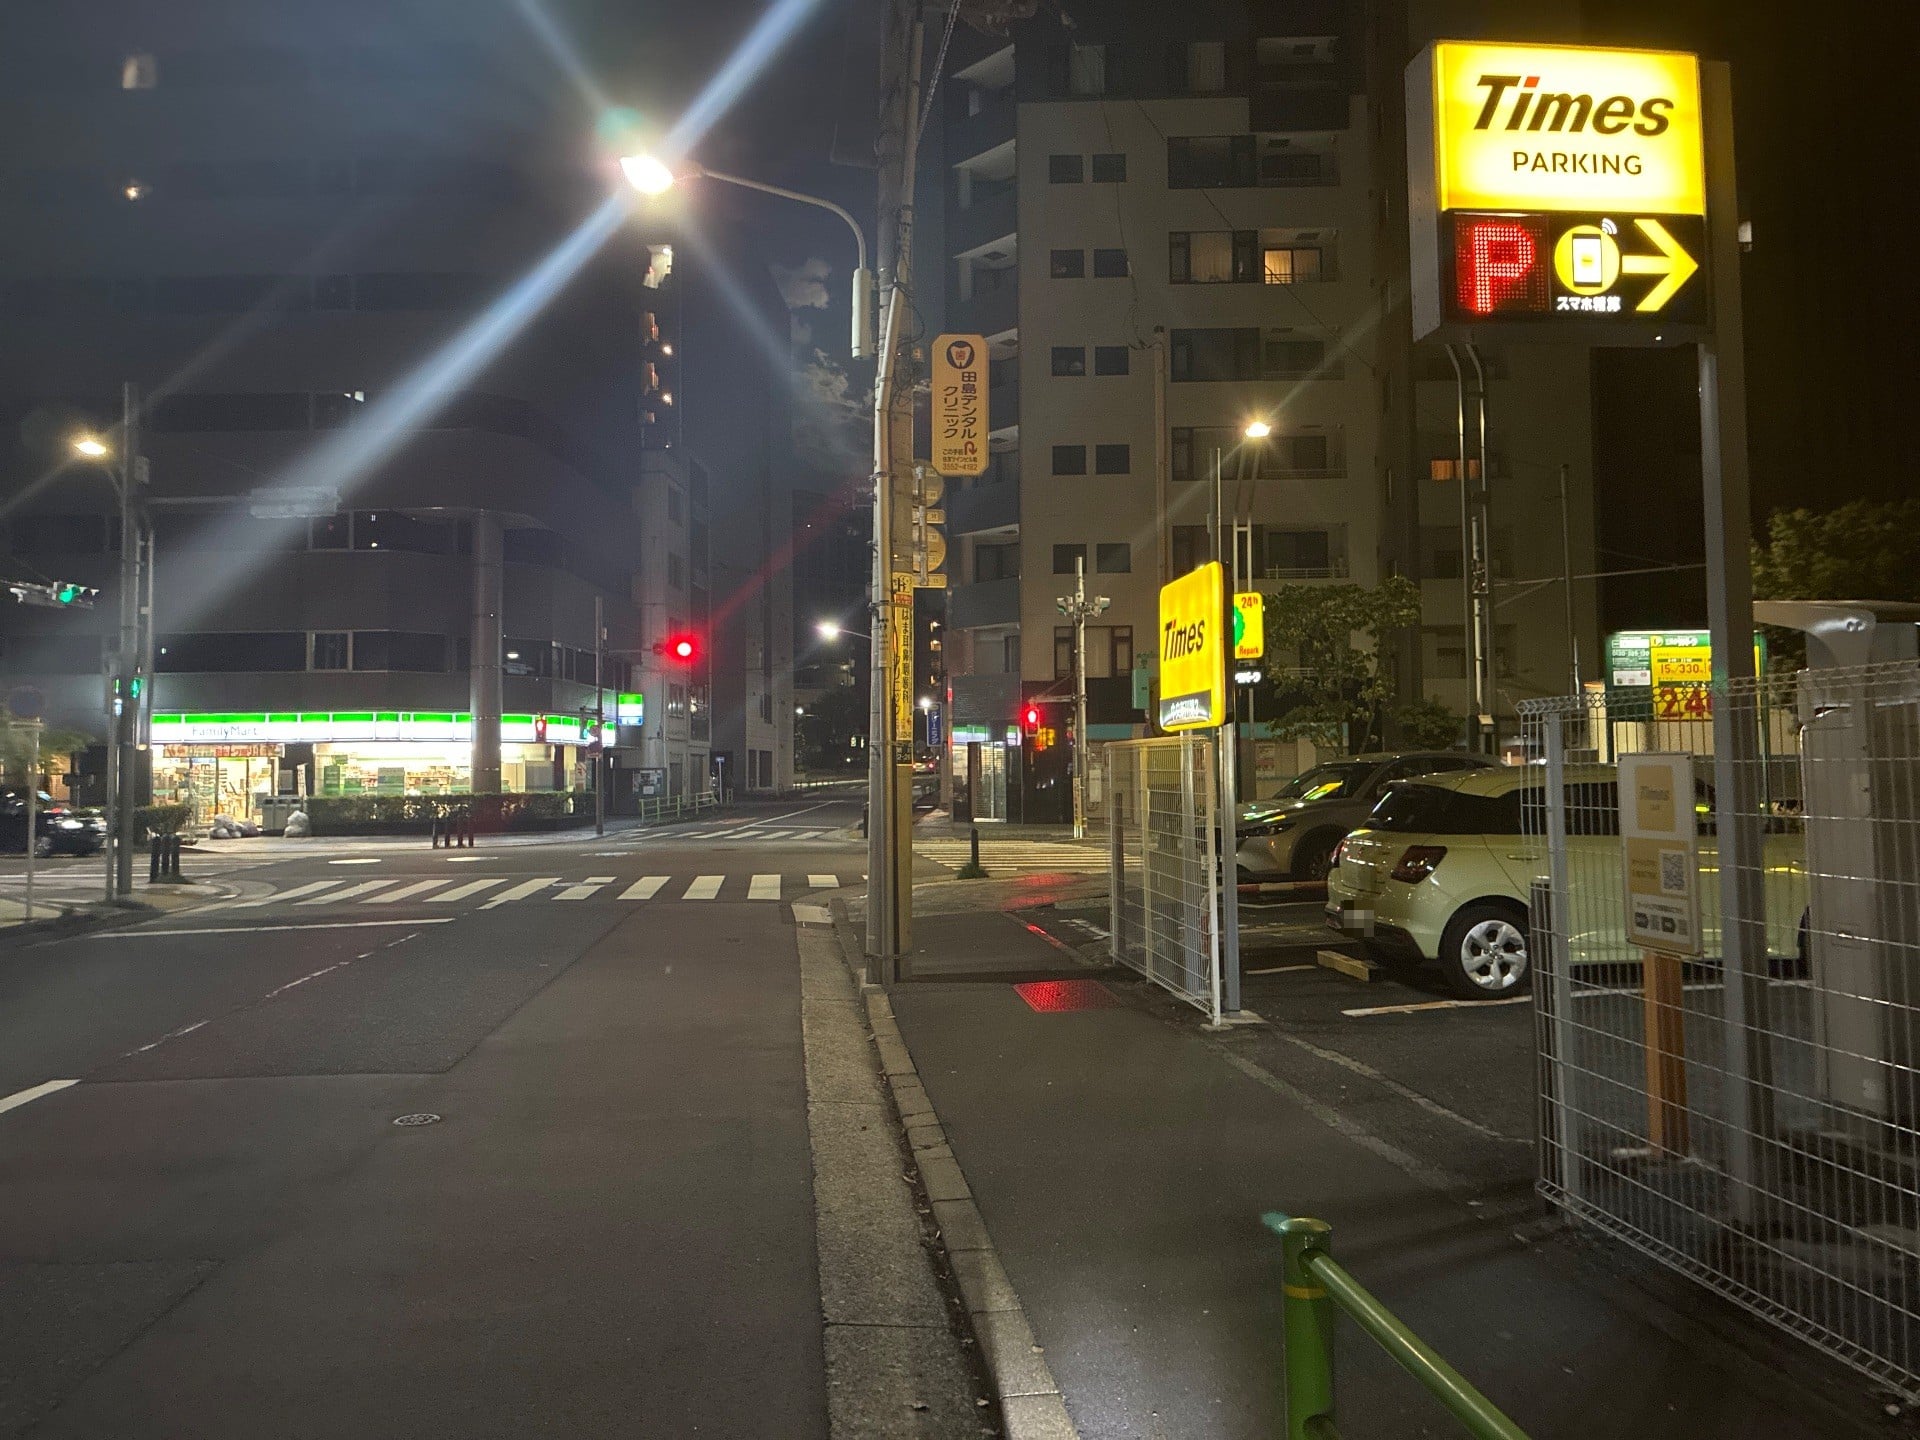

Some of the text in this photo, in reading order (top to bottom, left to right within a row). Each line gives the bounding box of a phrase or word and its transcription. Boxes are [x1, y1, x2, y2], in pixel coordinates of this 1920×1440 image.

[1474, 75, 1675, 137] Times
[1513, 151, 1643, 176] PARKING
[1473, 223, 1537, 314] P
[942, 386, 959, 439] クリニック
[961, 371, 977, 439] 田島デンタル
[1164, 619, 1206, 662] Times
[1239, 646, 1259, 656] Repark
[192, 726, 258, 739] FamilyMart
